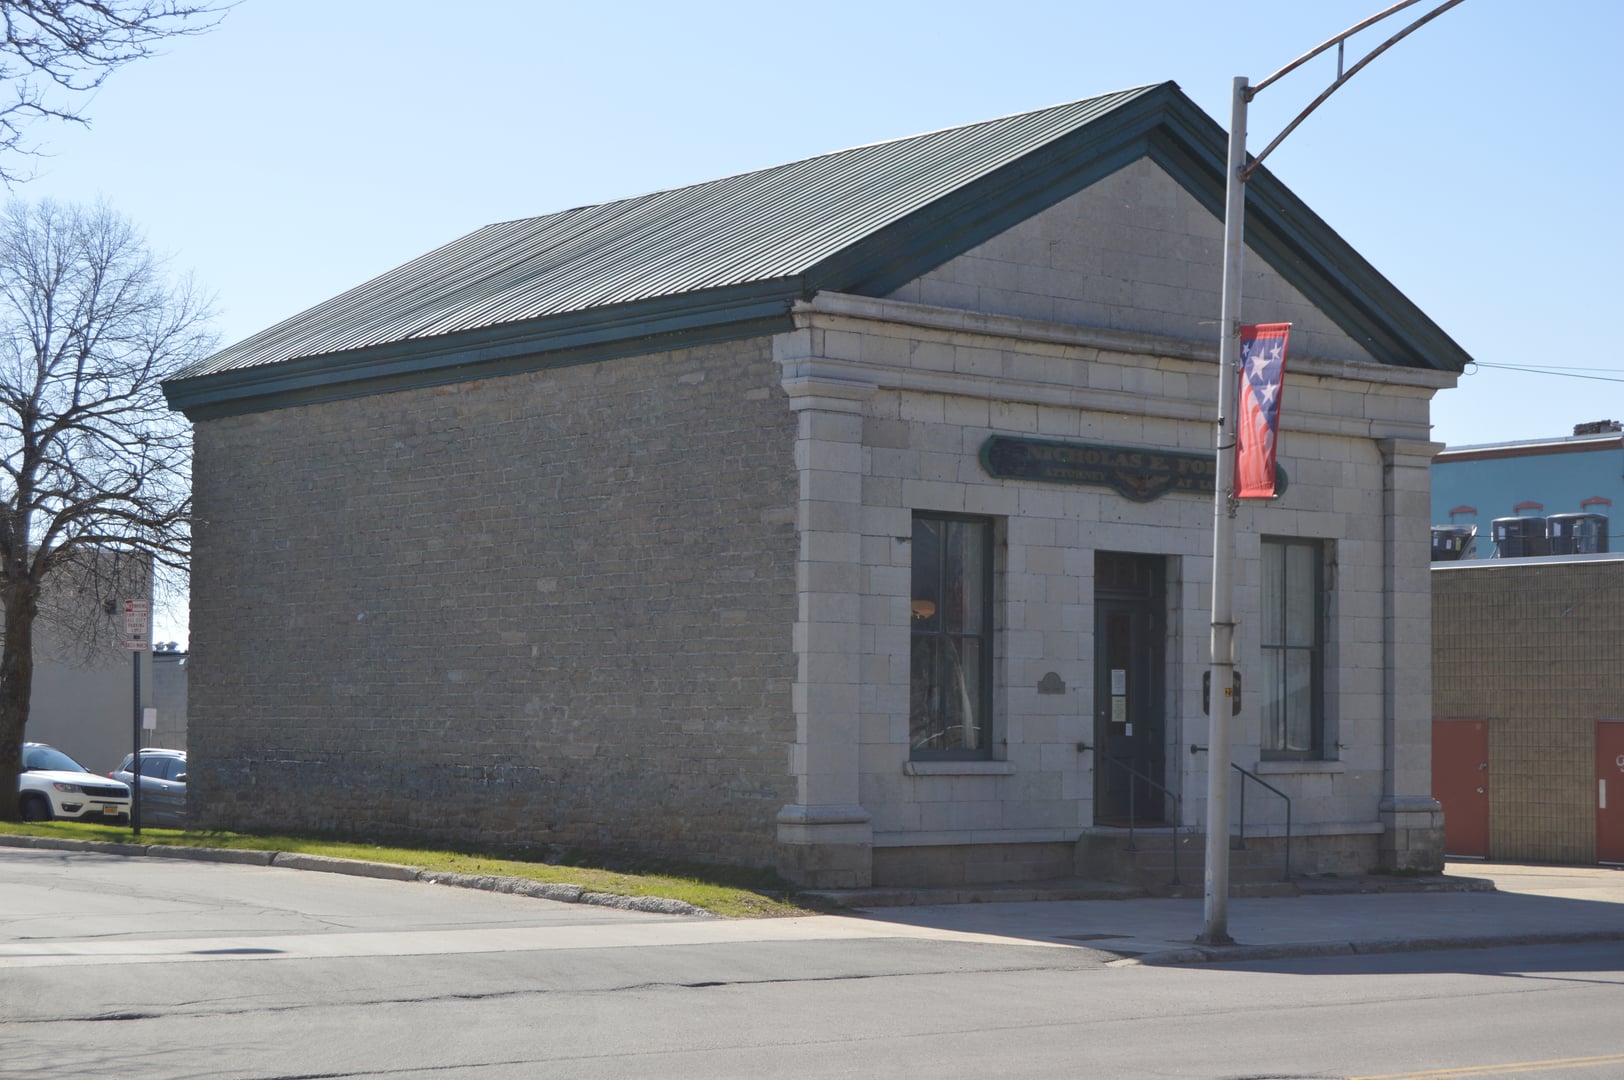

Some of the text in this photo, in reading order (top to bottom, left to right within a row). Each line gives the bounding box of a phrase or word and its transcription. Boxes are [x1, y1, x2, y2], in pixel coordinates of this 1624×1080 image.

[1028, 446, 1141, 467] NICHOLAS
[1046, 468, 1106, 480] ATTORNEY
[1200, 479, 1216, 490] LA
